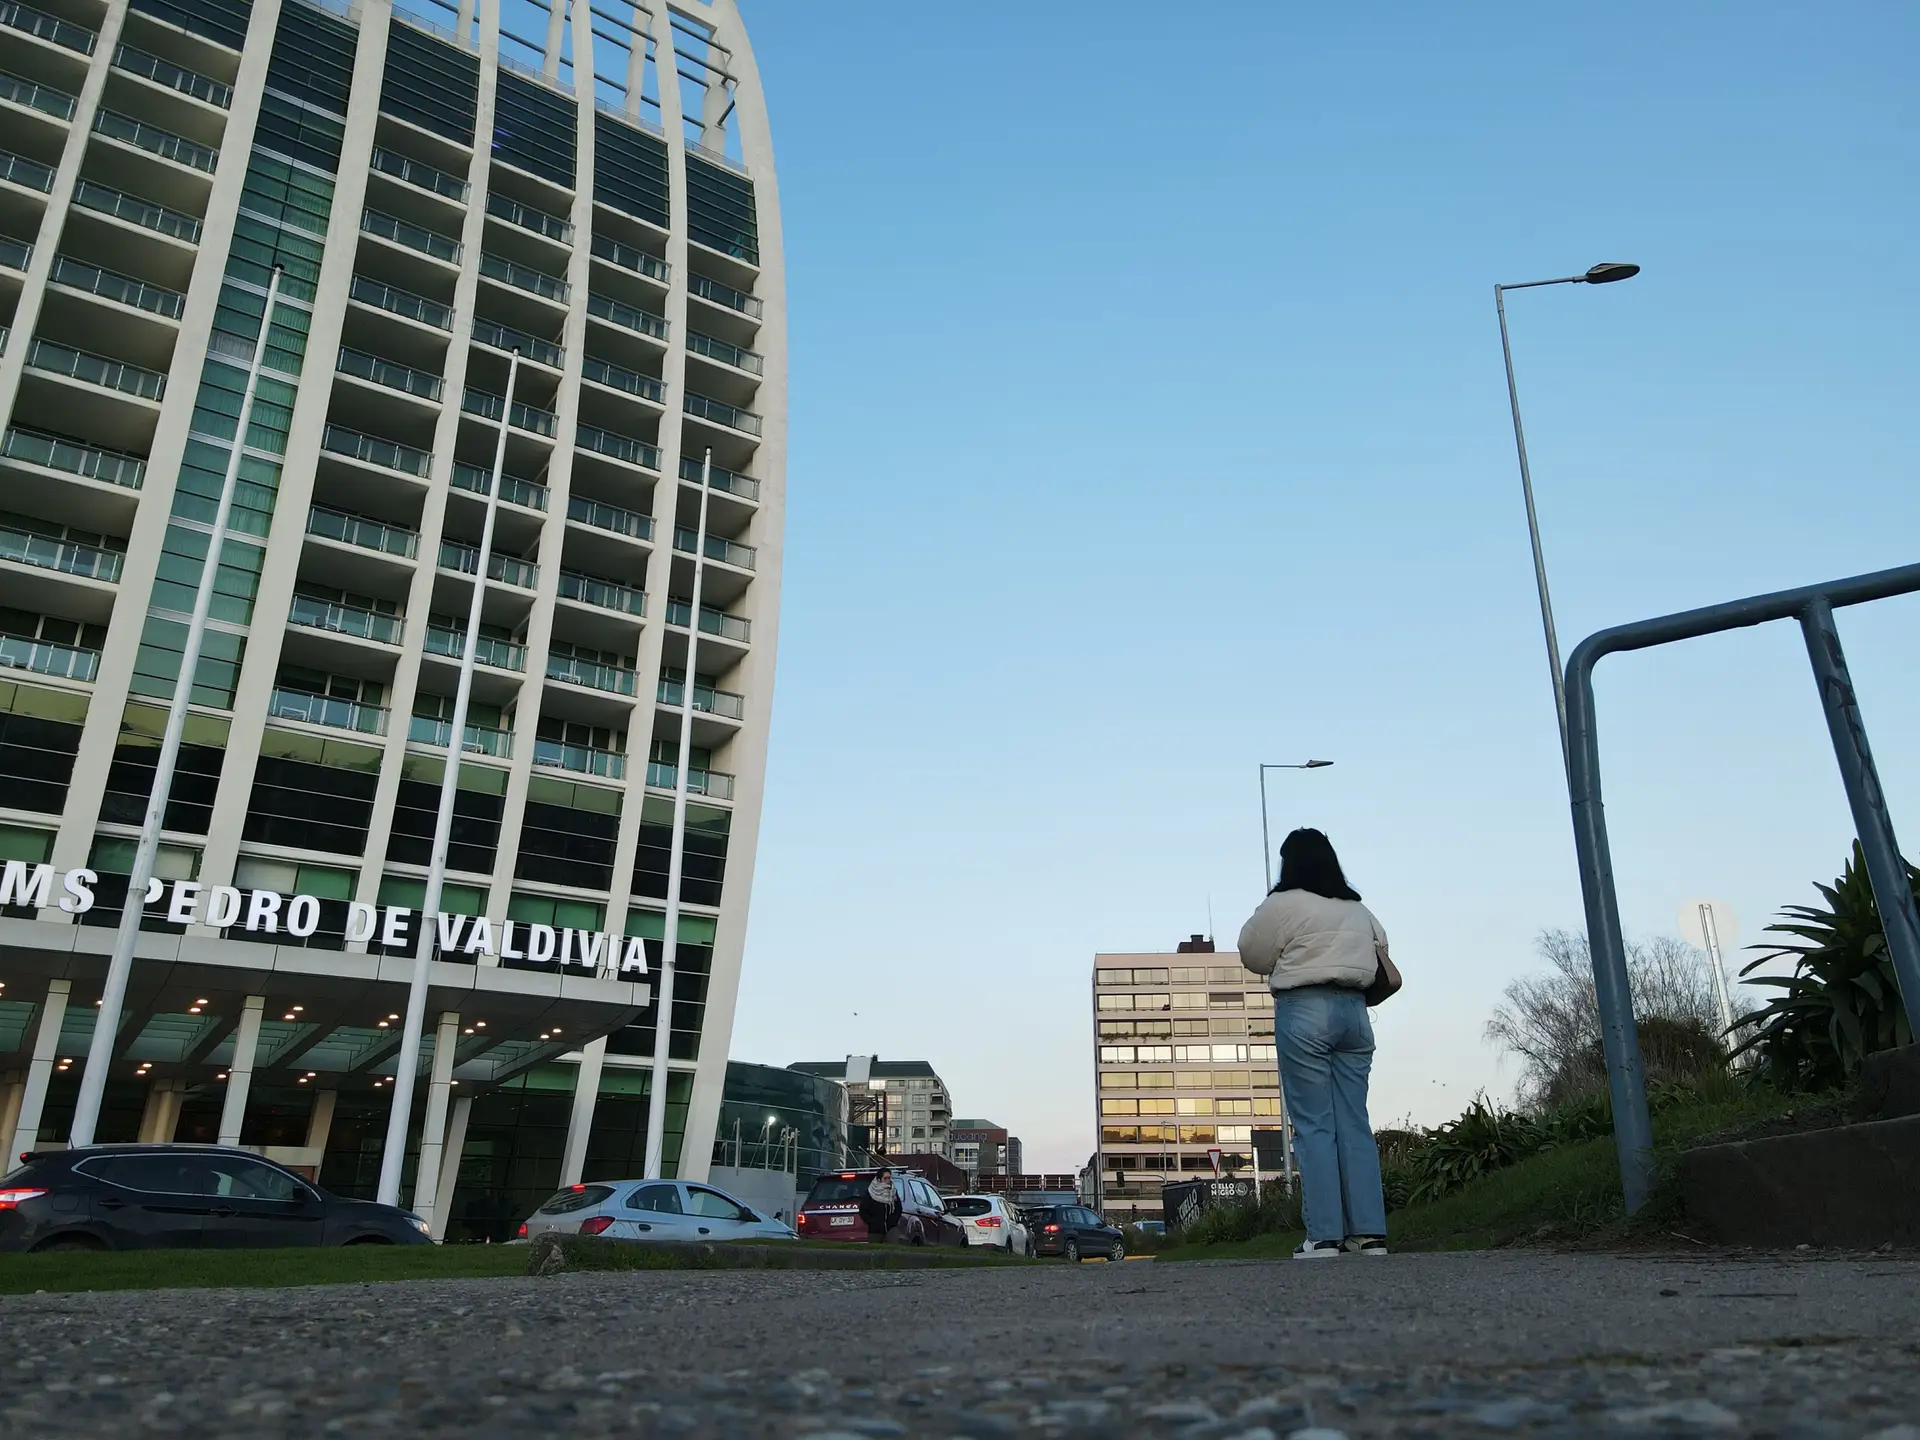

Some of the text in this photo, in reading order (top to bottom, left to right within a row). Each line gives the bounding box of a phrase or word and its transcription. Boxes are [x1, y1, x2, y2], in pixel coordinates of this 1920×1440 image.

[0, 860, 98, 913] MS
[344, 901, 411, 947] DE
[437, 911, 649, 975] VALDIVIA
[951, 1132, 987, 1141] ucana
